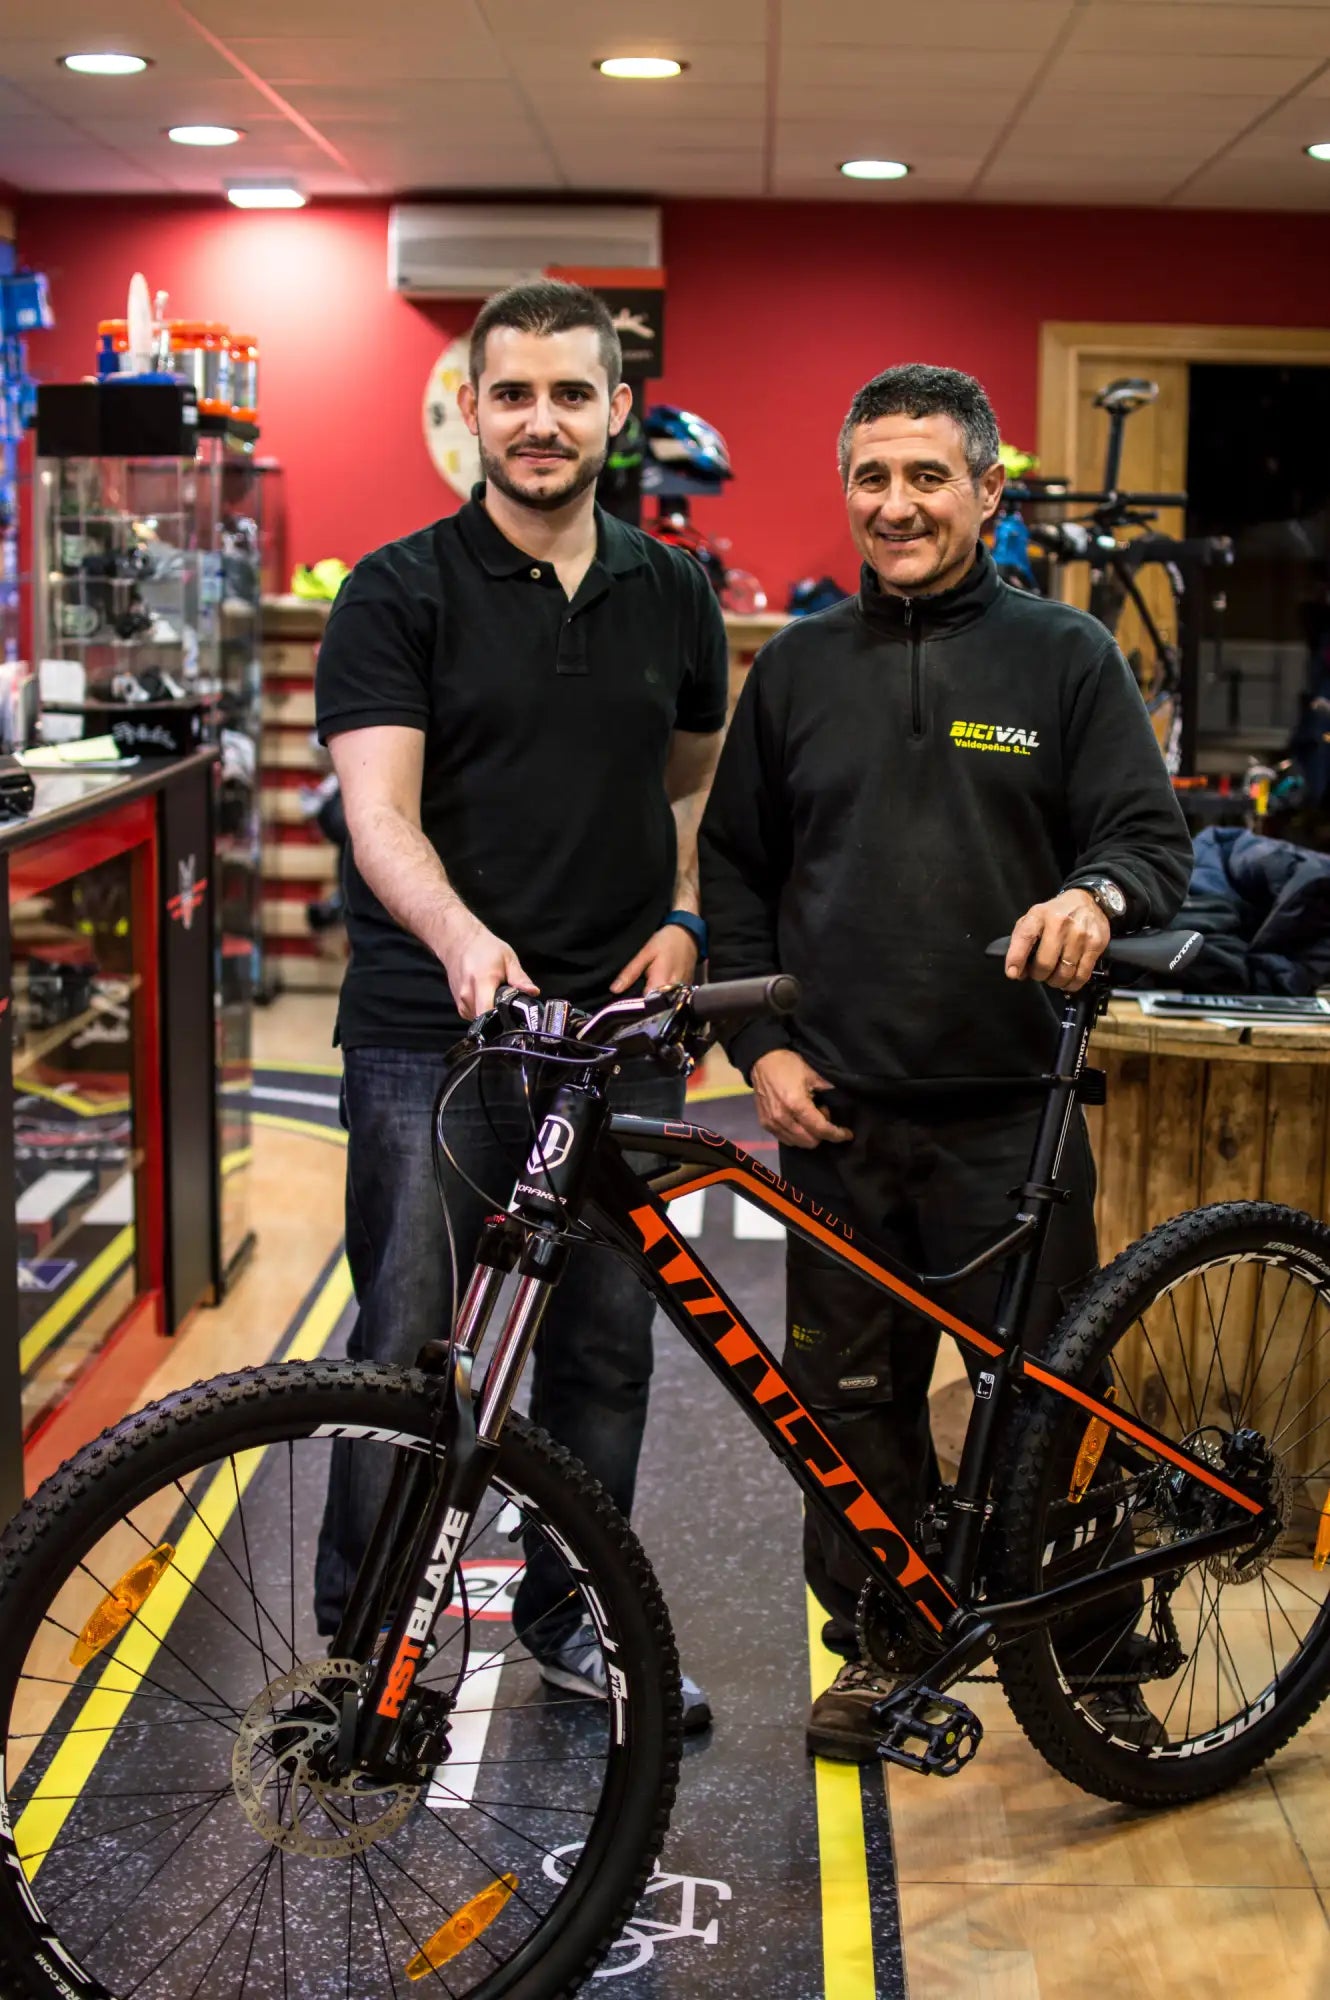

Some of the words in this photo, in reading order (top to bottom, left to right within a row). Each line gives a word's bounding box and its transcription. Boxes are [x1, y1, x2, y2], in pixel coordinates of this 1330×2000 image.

[949, 721, 1040, 748] BICIVAL
[954, 738, 1011, 753] Valdepeñas
[1013, 745, 1031, 756] S.L.
[376, 1634, 423, 1719] RST
[405, 1506, 470, 1642] BLAZE
